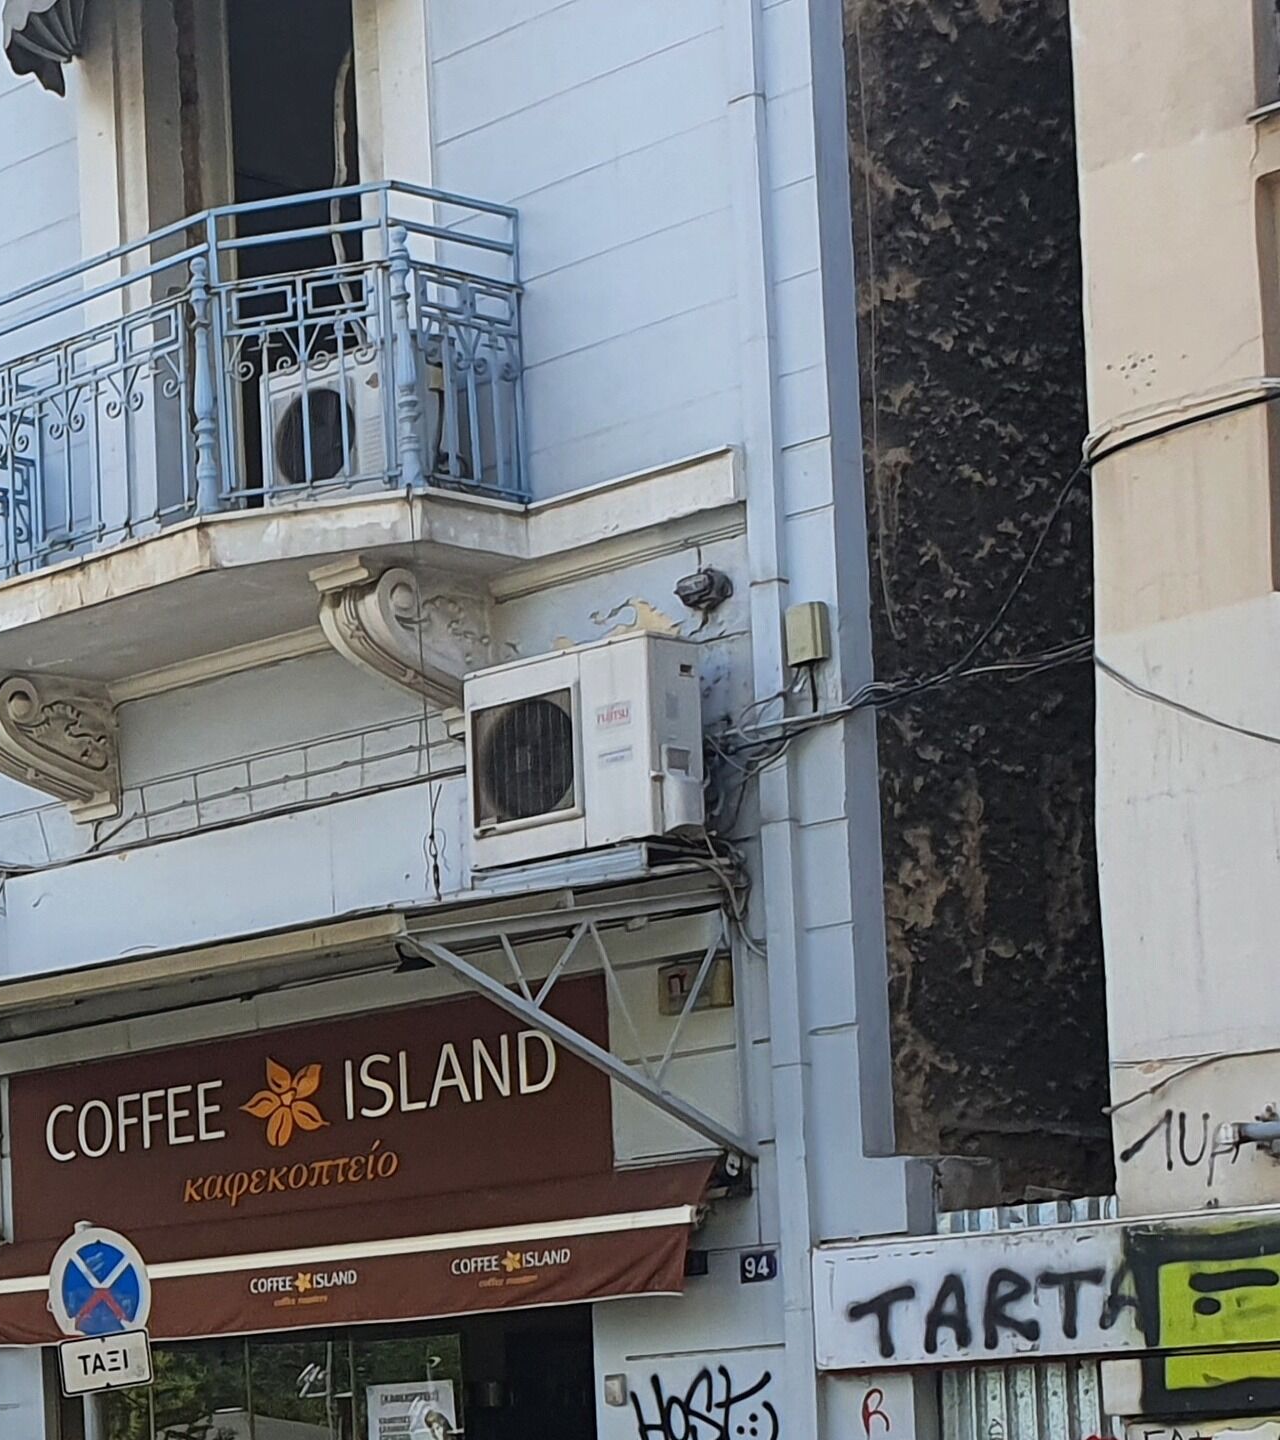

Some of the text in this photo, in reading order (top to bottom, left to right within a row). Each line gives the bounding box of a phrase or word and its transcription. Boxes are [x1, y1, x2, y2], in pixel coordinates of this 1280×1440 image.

[46, 1029, 557, 1163] COFFEE ISLAND
[184, 1140, 399, 1208] καφεκοπτείο
[451, 1248, 571, 1275] COFFEE ISLAND
[744, 1255, 771, 1279] 94
[250, 1270, 357, 1294] COFFEE ISLAND
[78, 1349, 129, 1376] ΤΑΞΙ
